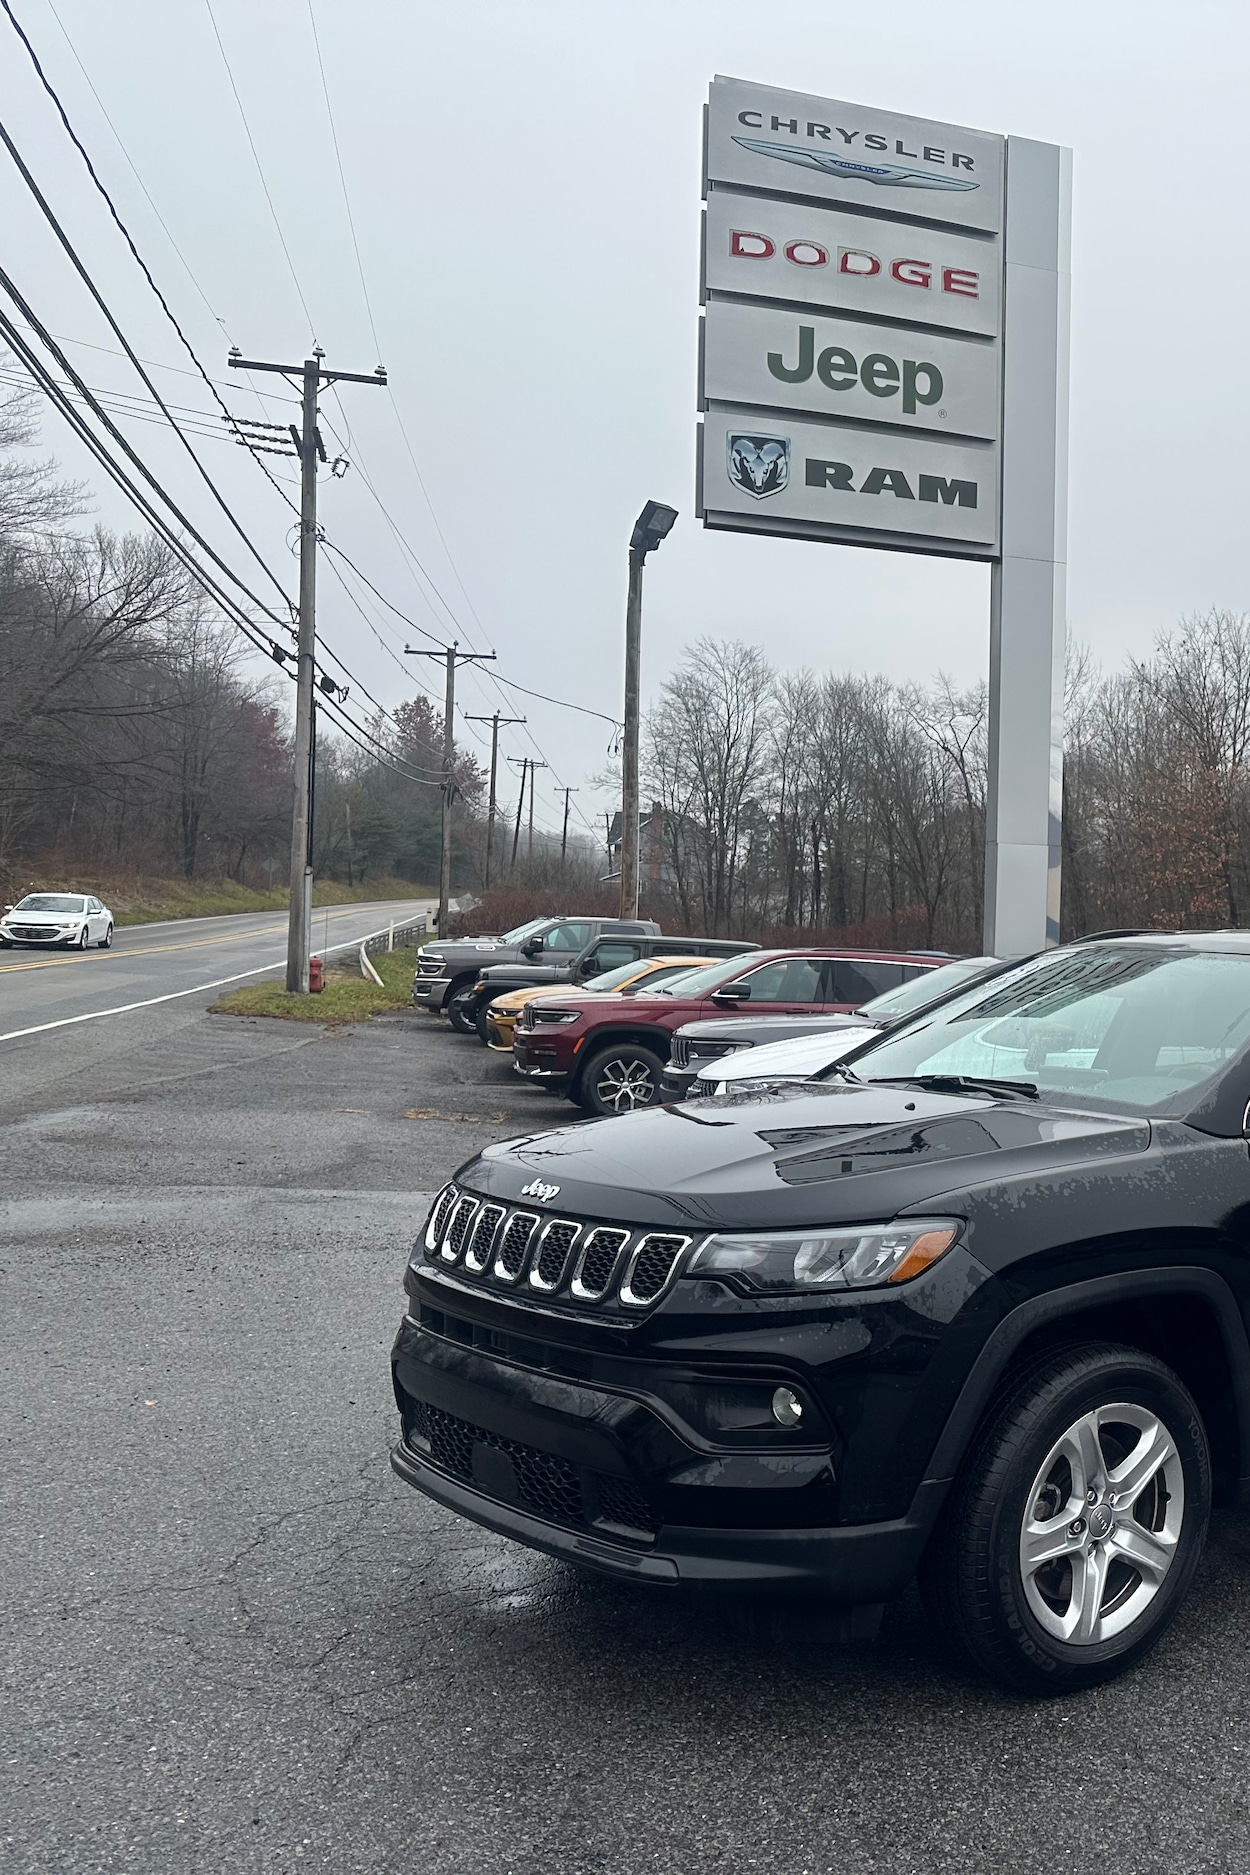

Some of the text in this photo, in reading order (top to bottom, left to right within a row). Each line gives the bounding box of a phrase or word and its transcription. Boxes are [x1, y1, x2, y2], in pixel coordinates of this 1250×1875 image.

[737, 110, 976, 172] CHRYSLER
[728, 228, 980, 299] DODGE
[766, 325, 944, 415] Jeep
[804, 457, 978, 510] RAM
[520, 1177, 562, 1203] Jeep
